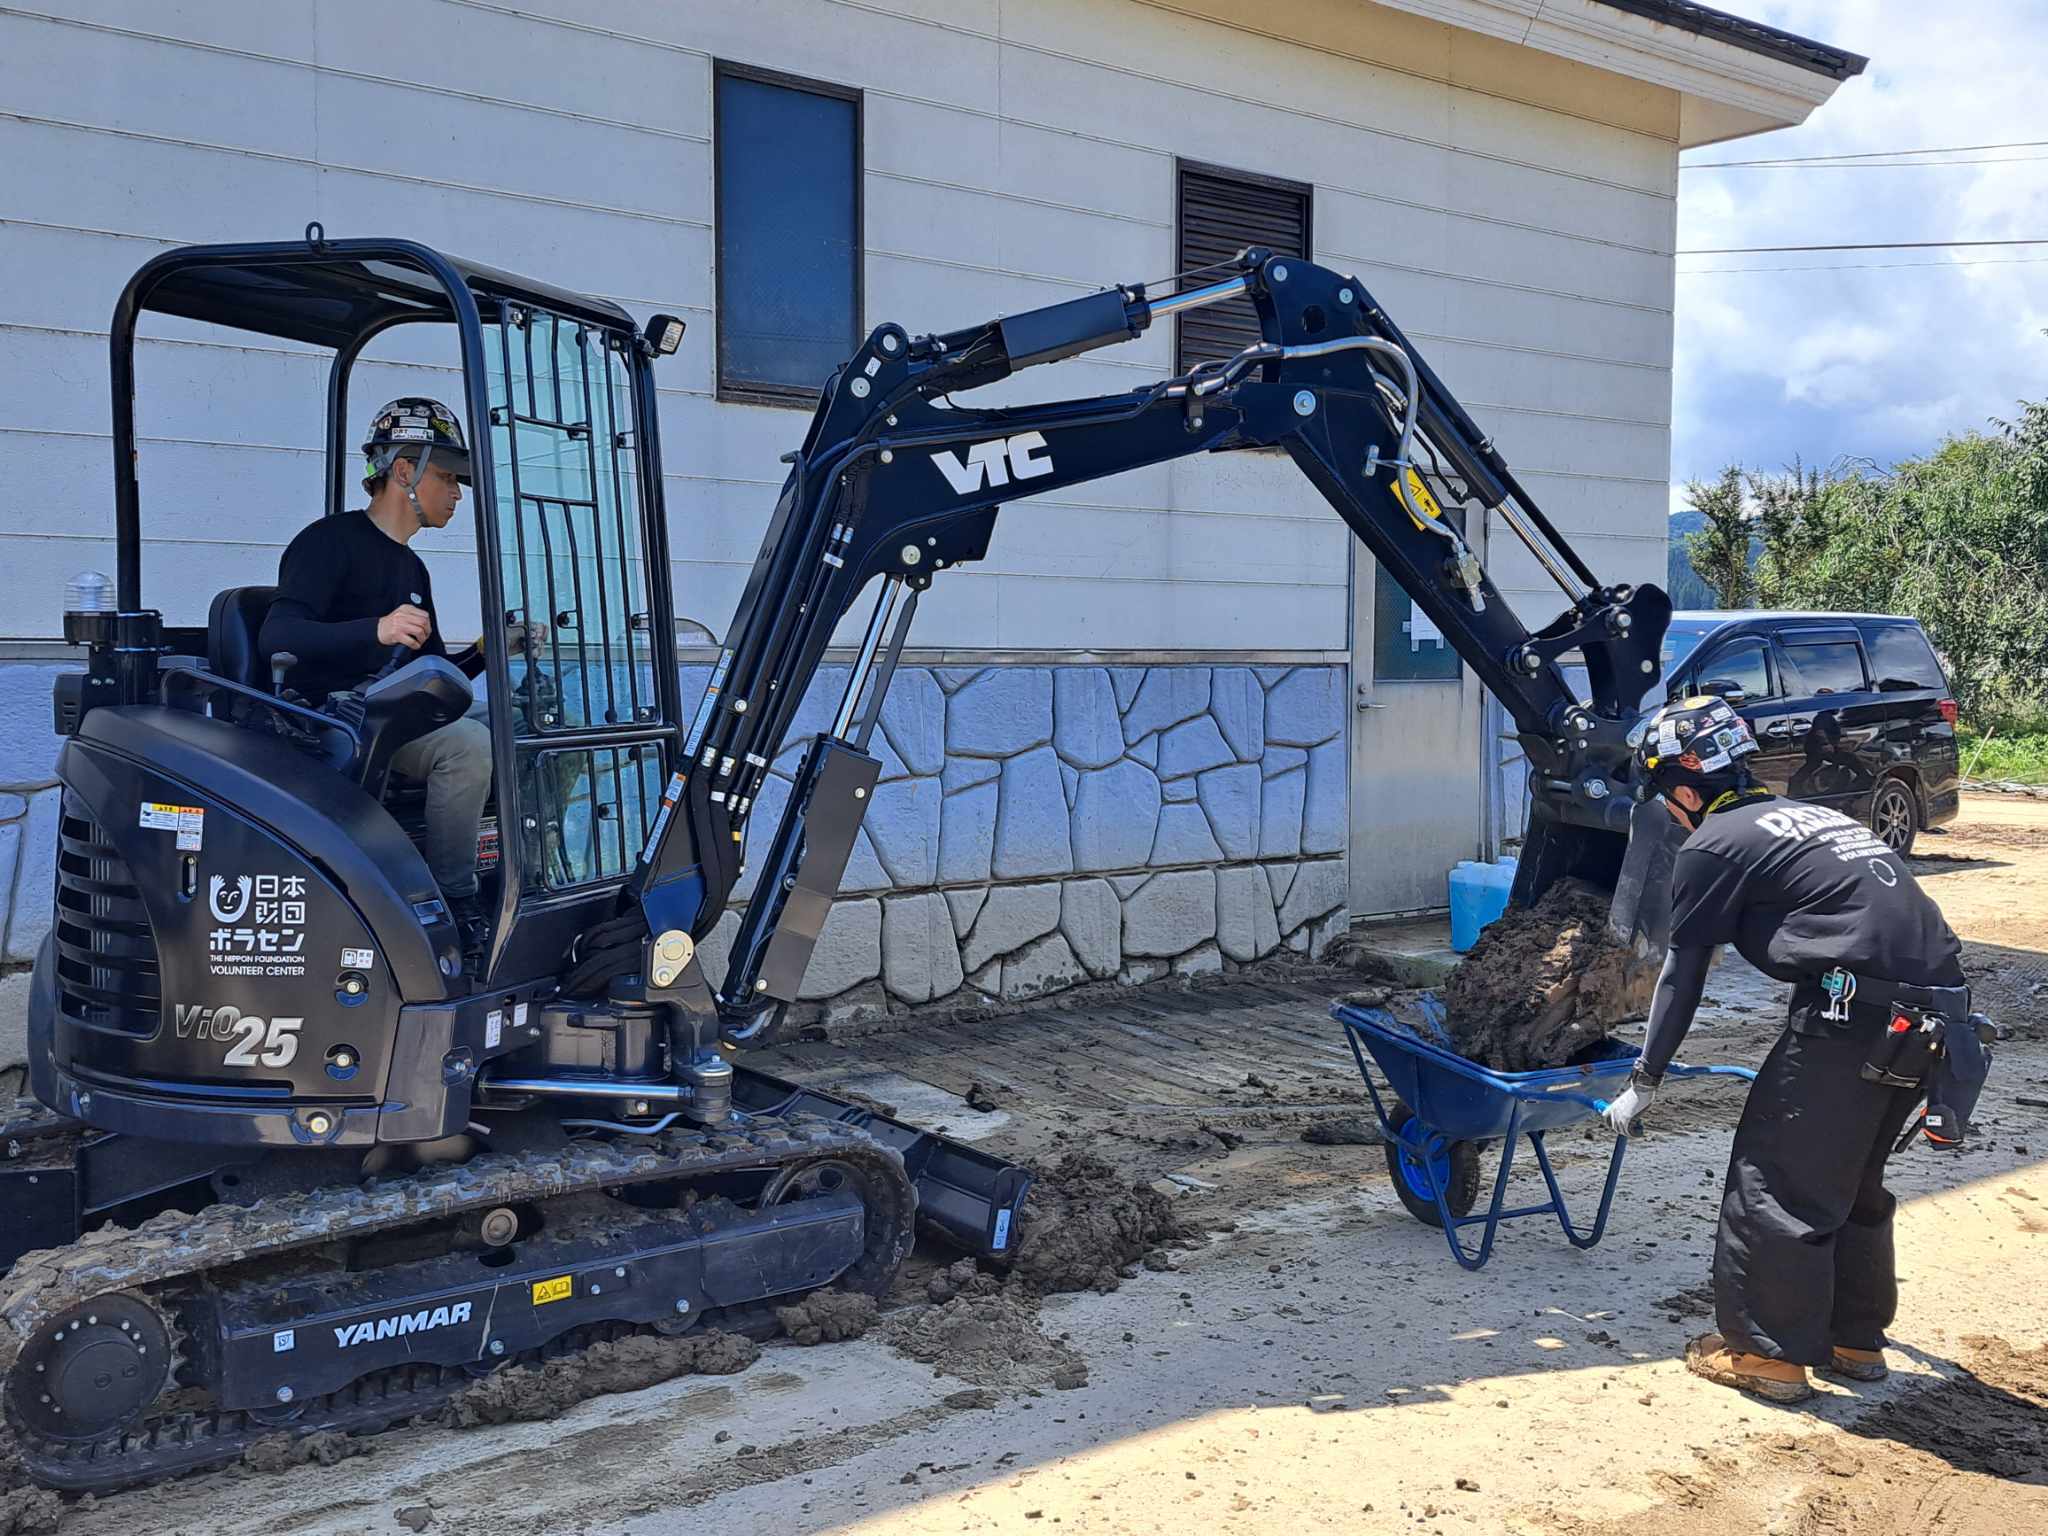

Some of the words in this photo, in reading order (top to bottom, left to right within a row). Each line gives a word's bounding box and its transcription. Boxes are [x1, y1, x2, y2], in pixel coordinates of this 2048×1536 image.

[929, 430, 1055, 496] VTC
[256, 875, 305, 898] 日本
[256, 901, 305, 924] 財団
[210, 928, 305, 951] ボラセン
[210, 954, 223, 963] THE
[224, 955, 253, 963] NIPPON
[254, 955, 305, 963] FOUNDATION
[210, 965, 264, 976] VOLUNTEER
[266, 966, 305, 976] CENTER
[333, 1301, 472, 1348] YANMAR
